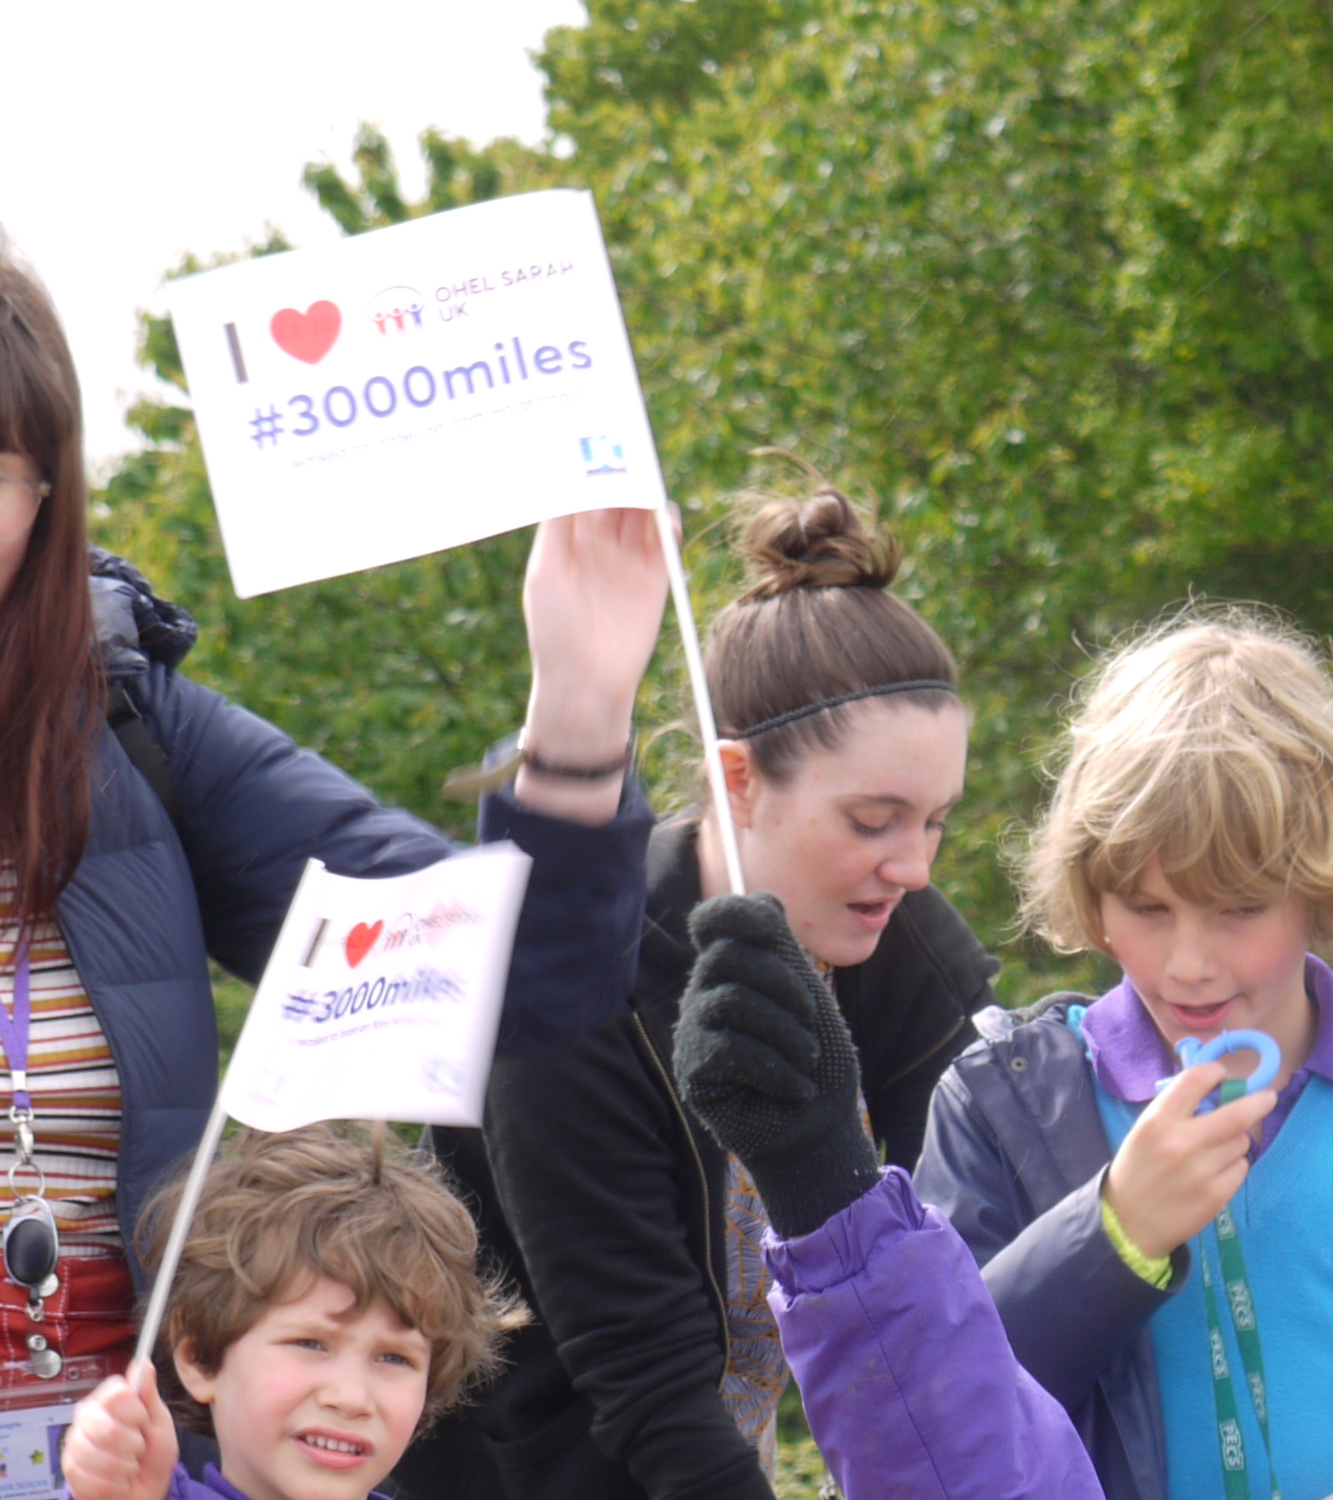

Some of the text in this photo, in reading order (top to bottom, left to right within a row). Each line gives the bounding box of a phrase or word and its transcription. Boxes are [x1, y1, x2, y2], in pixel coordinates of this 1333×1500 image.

[223, 261, 574, 383] I OHEL SARAH
[439, 301, 469, 323] UK
[249, 336, 593, 450] #3000miles
[300, 917, 332, 968] I
[281, 966, 468, 1024] #3000miles
[1220, 1420, 1245, 1470] PECS
